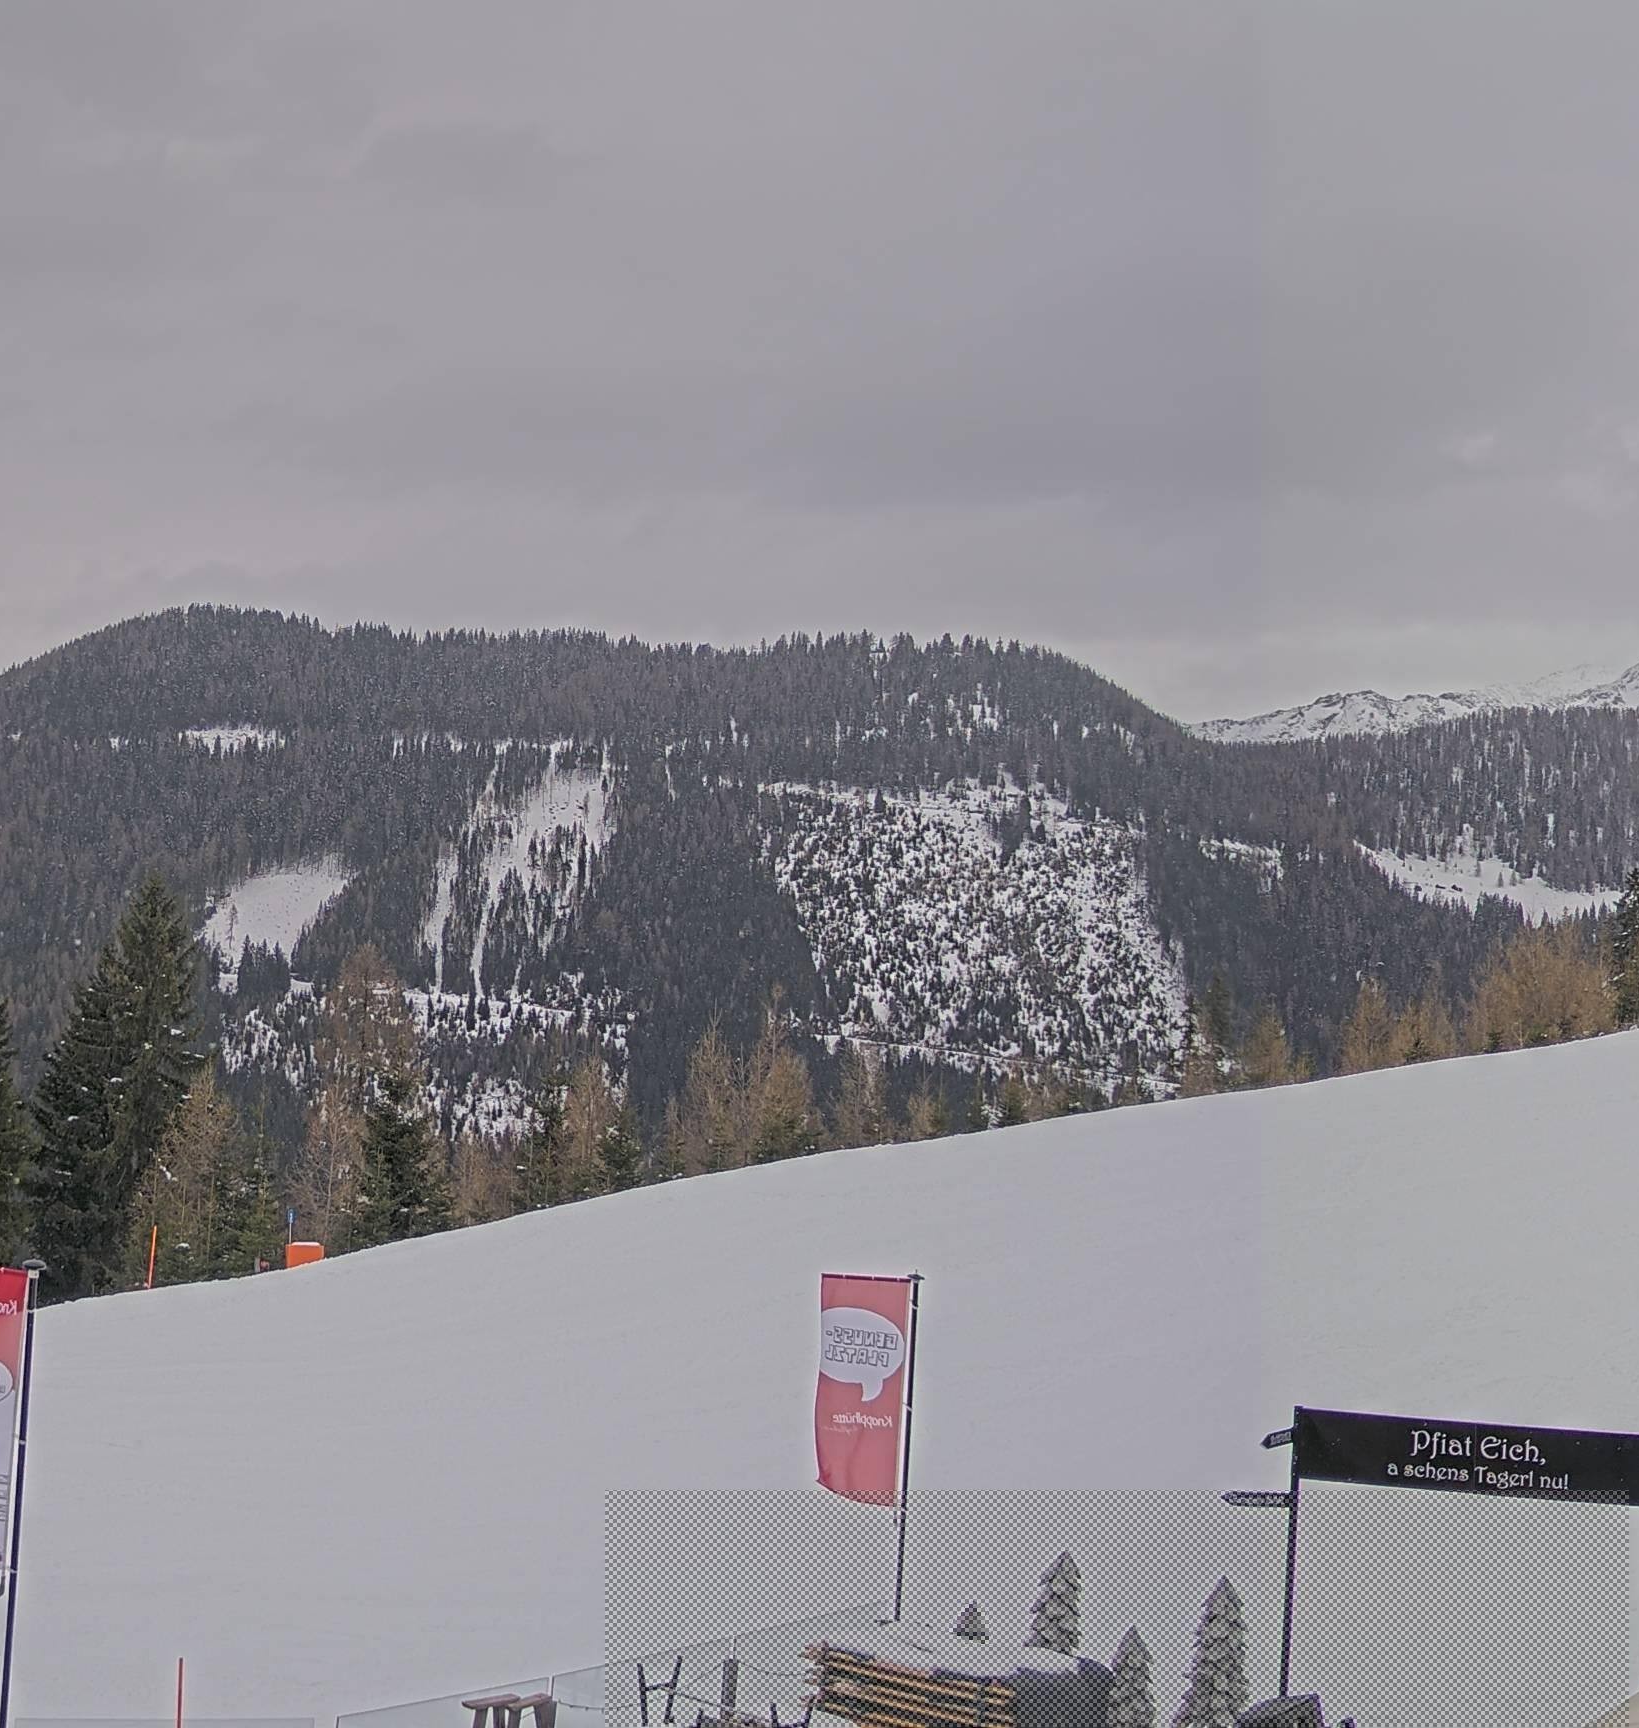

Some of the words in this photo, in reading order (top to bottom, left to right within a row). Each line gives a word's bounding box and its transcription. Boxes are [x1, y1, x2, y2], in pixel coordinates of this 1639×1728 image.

[1409, 1429, 1472, 1459] Pfiat
[1480, 1435, 1547, 1466] Eich,
[1387, 1462, 1399, 1476] a
[1403, 1461, 1470, 1482] schens
[1474, 1466, 1534, 1489] Tagerl
[1539, 1473, 1570, 1490] nu!
